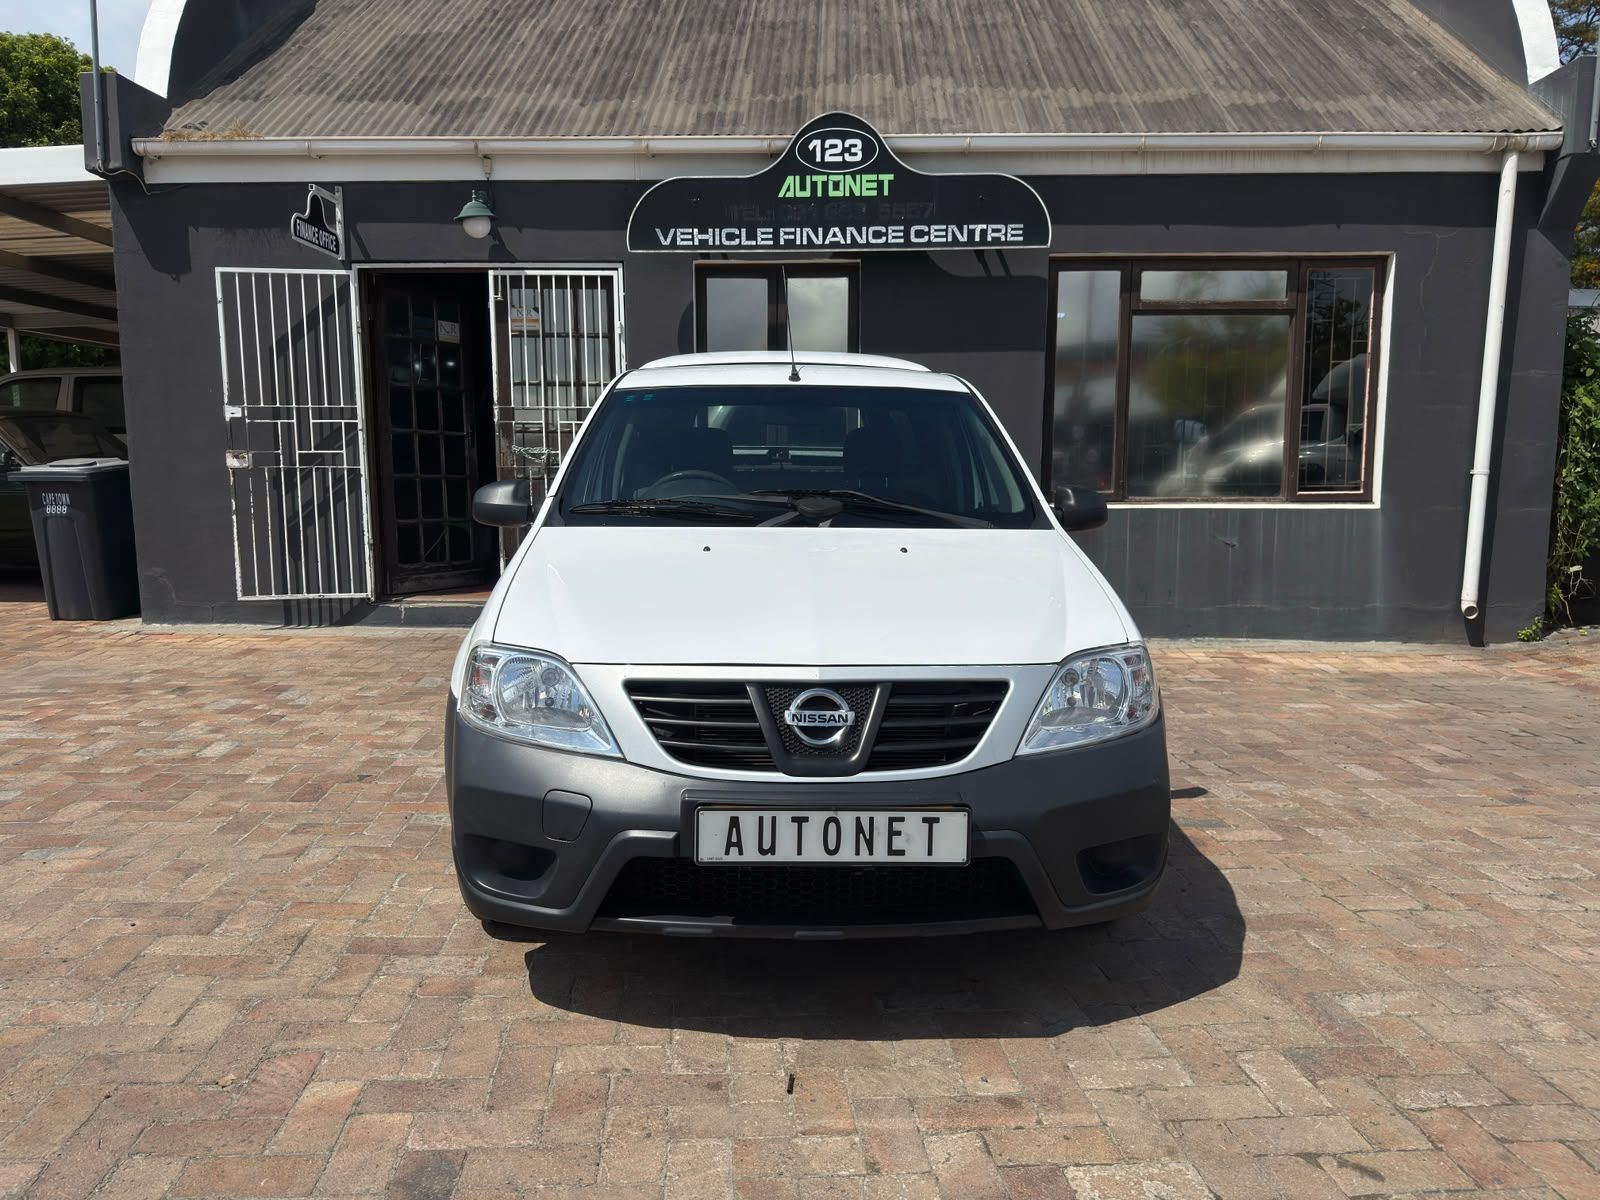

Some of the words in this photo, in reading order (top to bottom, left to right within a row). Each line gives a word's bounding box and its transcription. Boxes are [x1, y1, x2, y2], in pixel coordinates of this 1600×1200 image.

[808, 138, 863, 163] 123
[778, 173, 895, 198] AUTONET
[296, 219, 319, 245] FINANCE
[319, 229, 337, 252] OFFICE
[655, 227, 773, 247] VEHICLE
[779, 225, 905, 246] FINANCE
[910, 223, 1024, 243] CENTRE
[42, 492, 56, 505] CAPE
[55, 492, 71, 505] TOWN
[791, 713, 849, 723] NISSAN
[724, 815, 941, 856] AUTONET
